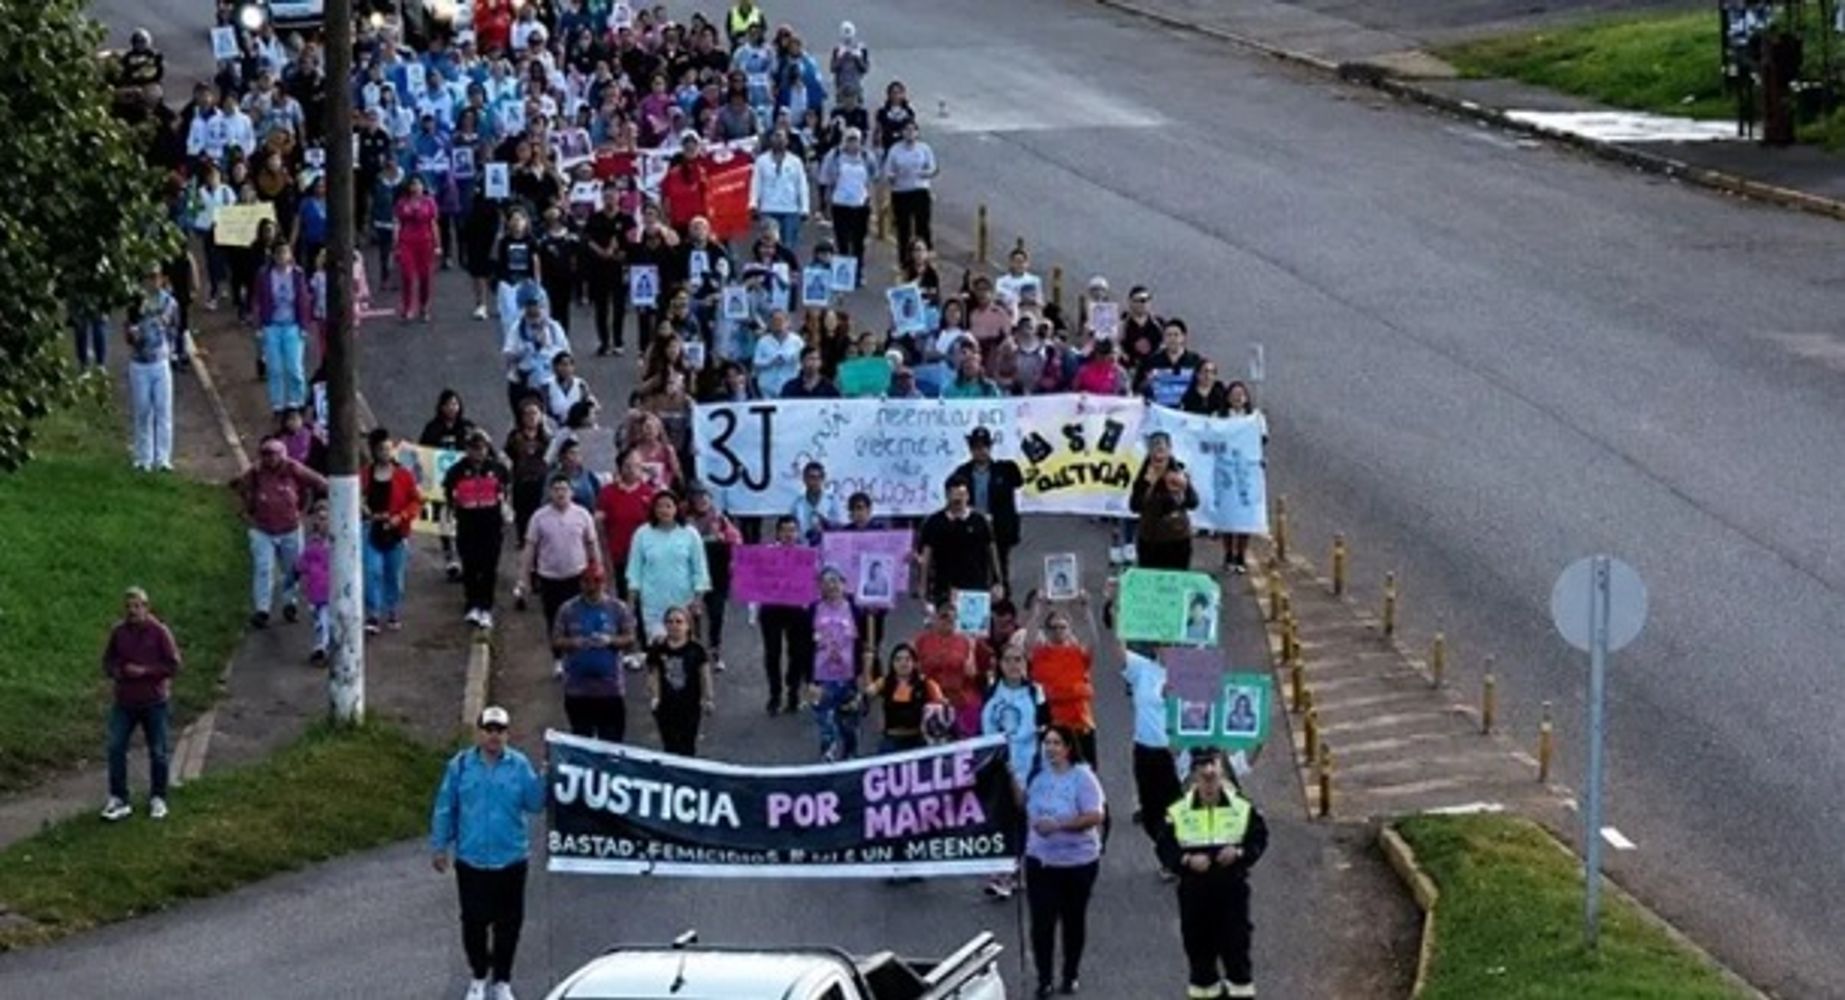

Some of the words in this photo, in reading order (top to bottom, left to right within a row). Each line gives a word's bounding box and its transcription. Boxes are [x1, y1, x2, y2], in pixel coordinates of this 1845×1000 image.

[554, 764, 740, 828] JUSTICIA
[767, 791, 841, 828] POR
[863, 750, 977, 801] GULLE
[907, 832, 1006, 860] MEENOS
